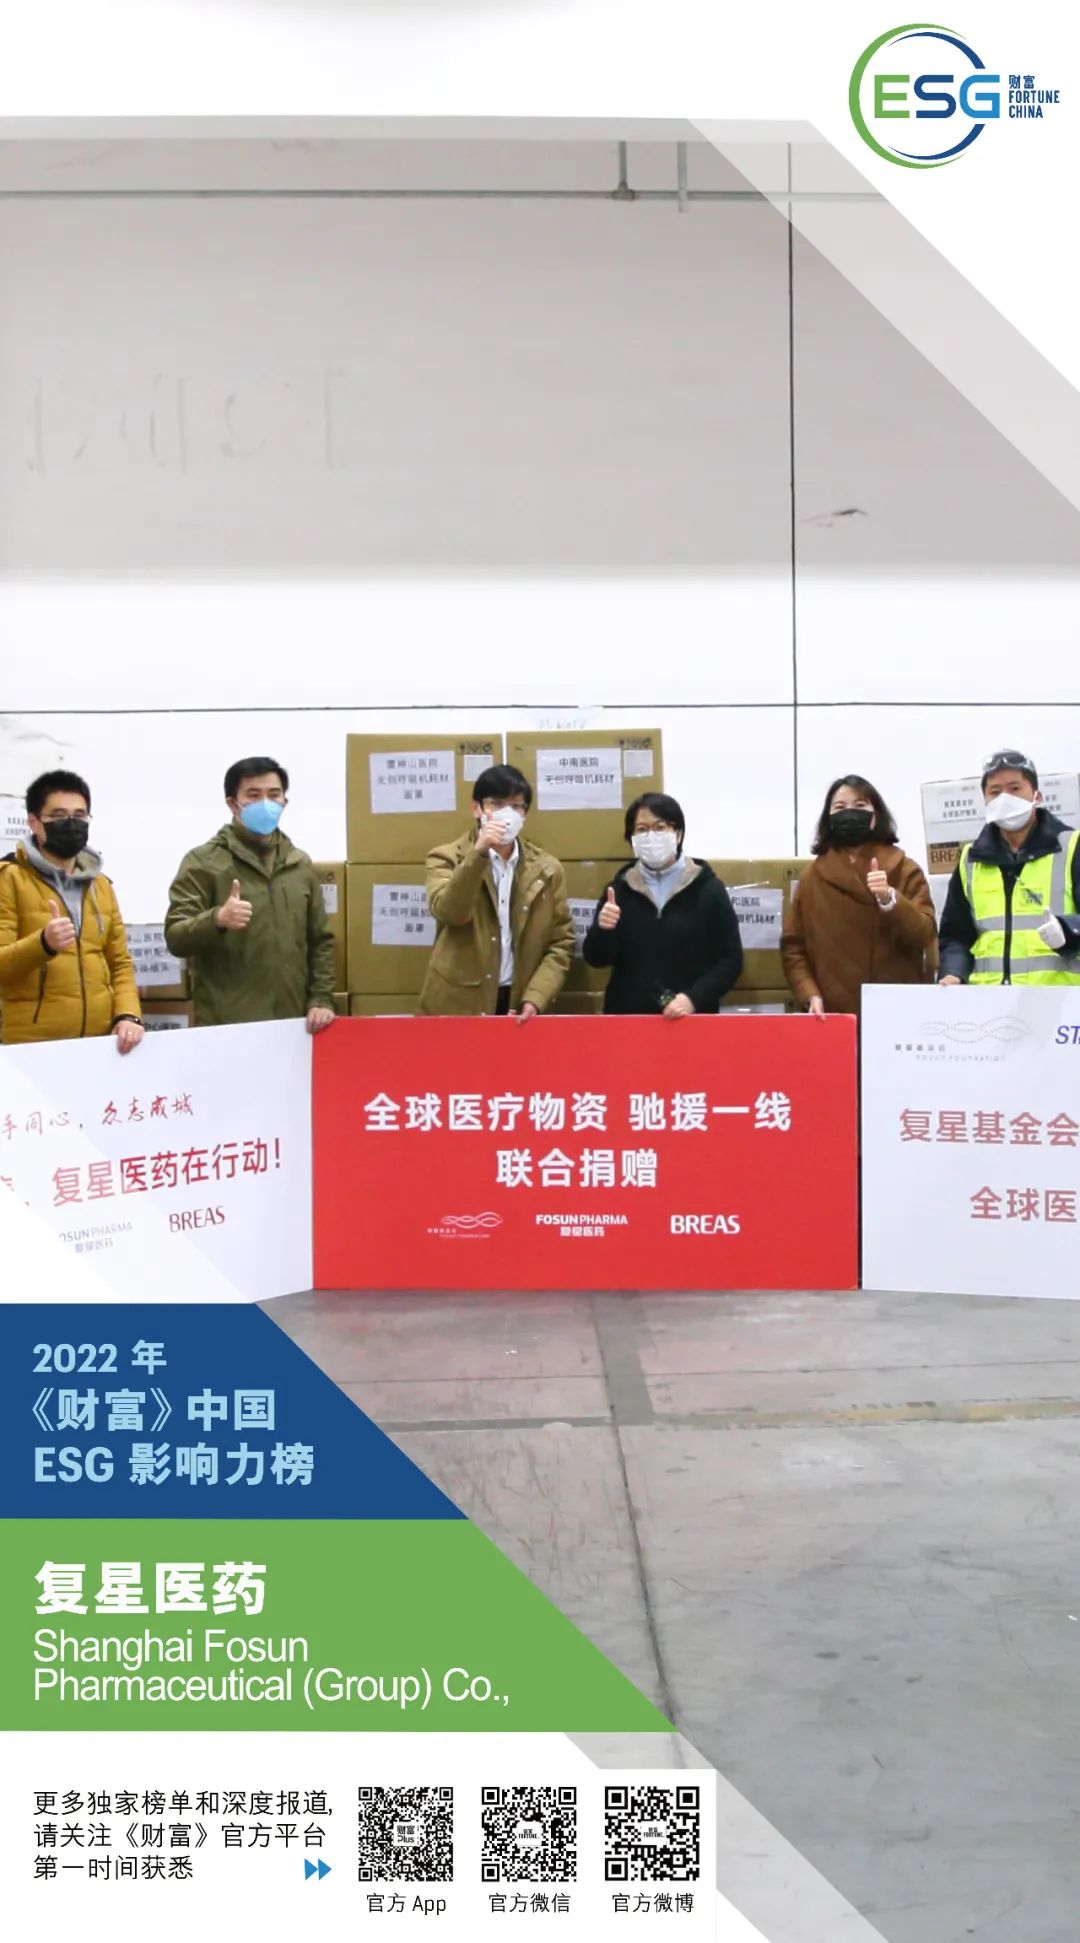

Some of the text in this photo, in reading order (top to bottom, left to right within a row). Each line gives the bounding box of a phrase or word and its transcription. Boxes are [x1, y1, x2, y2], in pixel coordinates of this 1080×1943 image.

[1055, 1025, 1080, 1045] ST
[364, 1092, 791, 1132] 全球医疗物资 驰援一线
[900, 1108, 1079, 1147] 复星基金会
[496, 1148, 657, 1188] 联合捐赠
[168, 1206, 226, 1233] BREAS
[970, 1186, 1077, 1223] 全球医
[670, 1214, 741, 1235] BREAS
